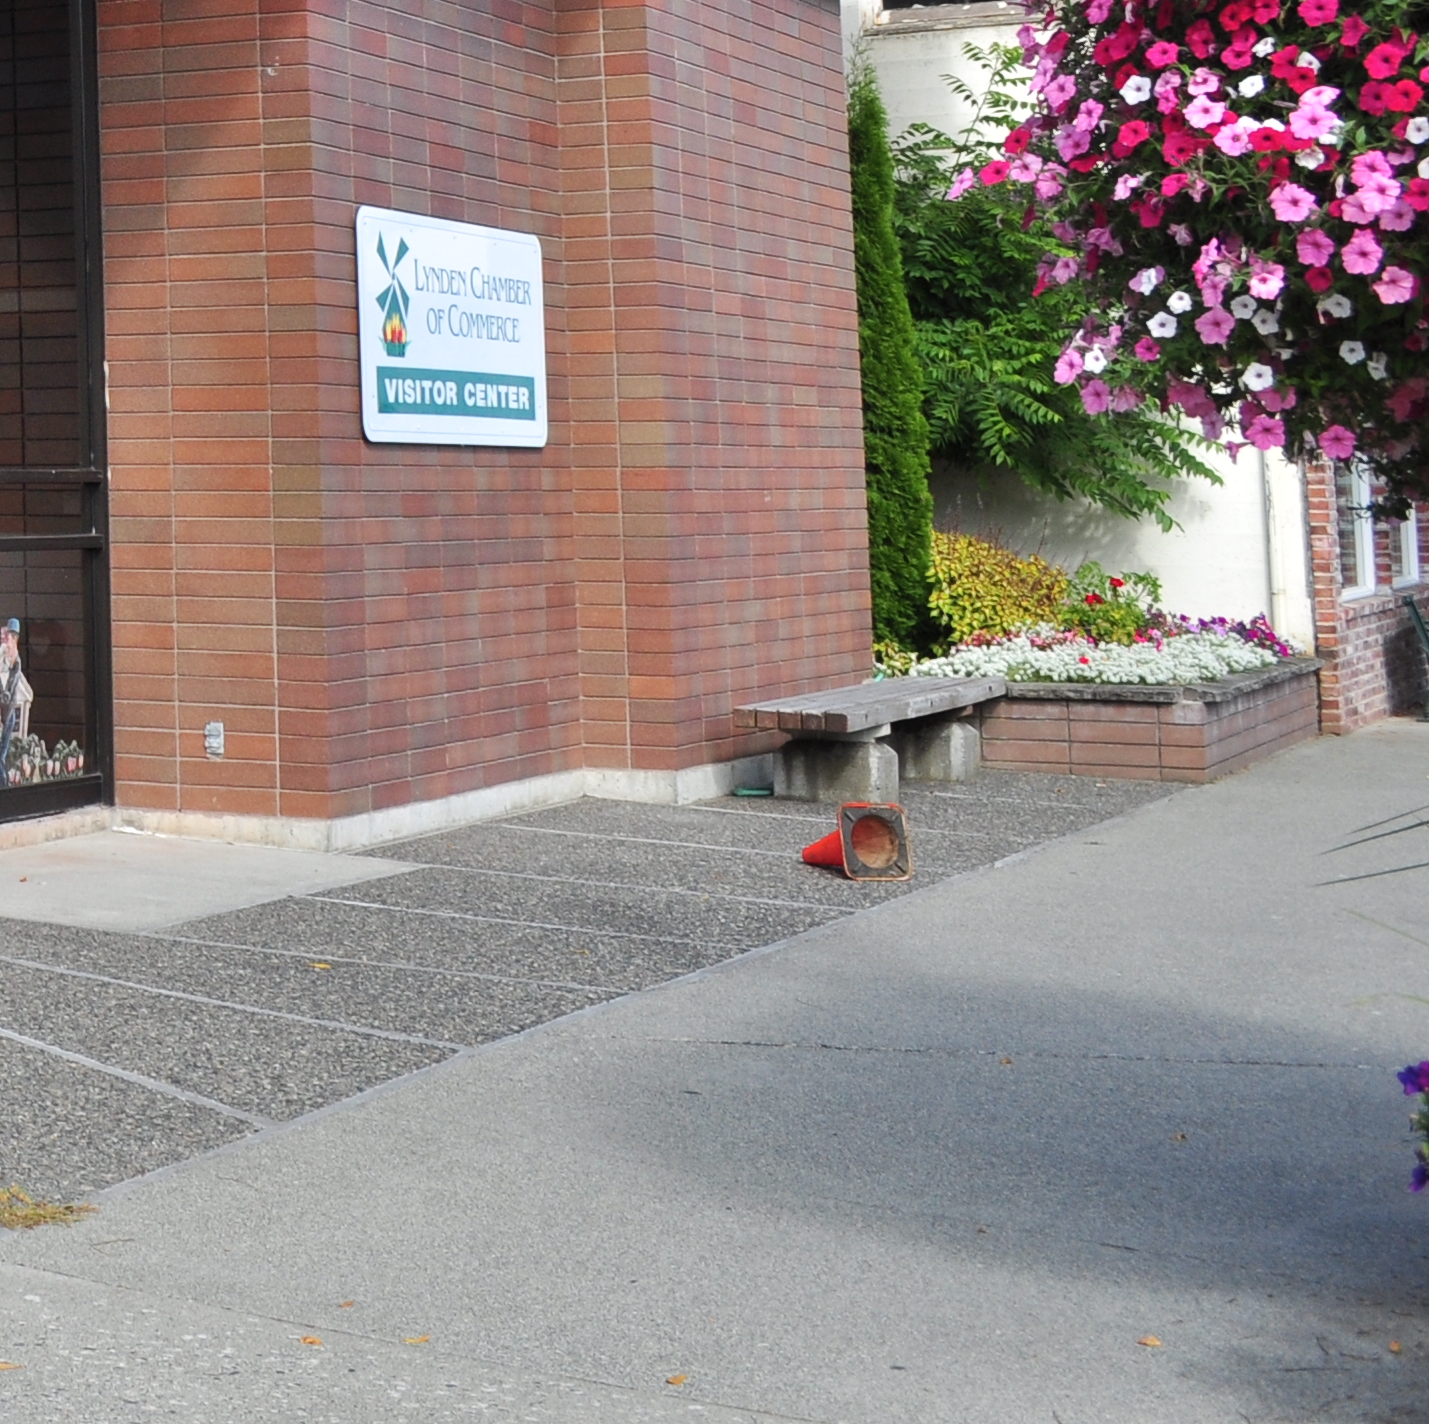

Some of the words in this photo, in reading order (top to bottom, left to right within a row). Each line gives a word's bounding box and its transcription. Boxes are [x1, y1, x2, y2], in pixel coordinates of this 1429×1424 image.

[414, 258, 467, 297] LYNDEN
[470, 266, 532, 306] CHAMBER
[426, 307, 445, 335] OF
[447, 304, 521, 344] COMMERCE
[384, 377, 458, 407] VISITOR
[463, 381, 530, 411] CENTER
